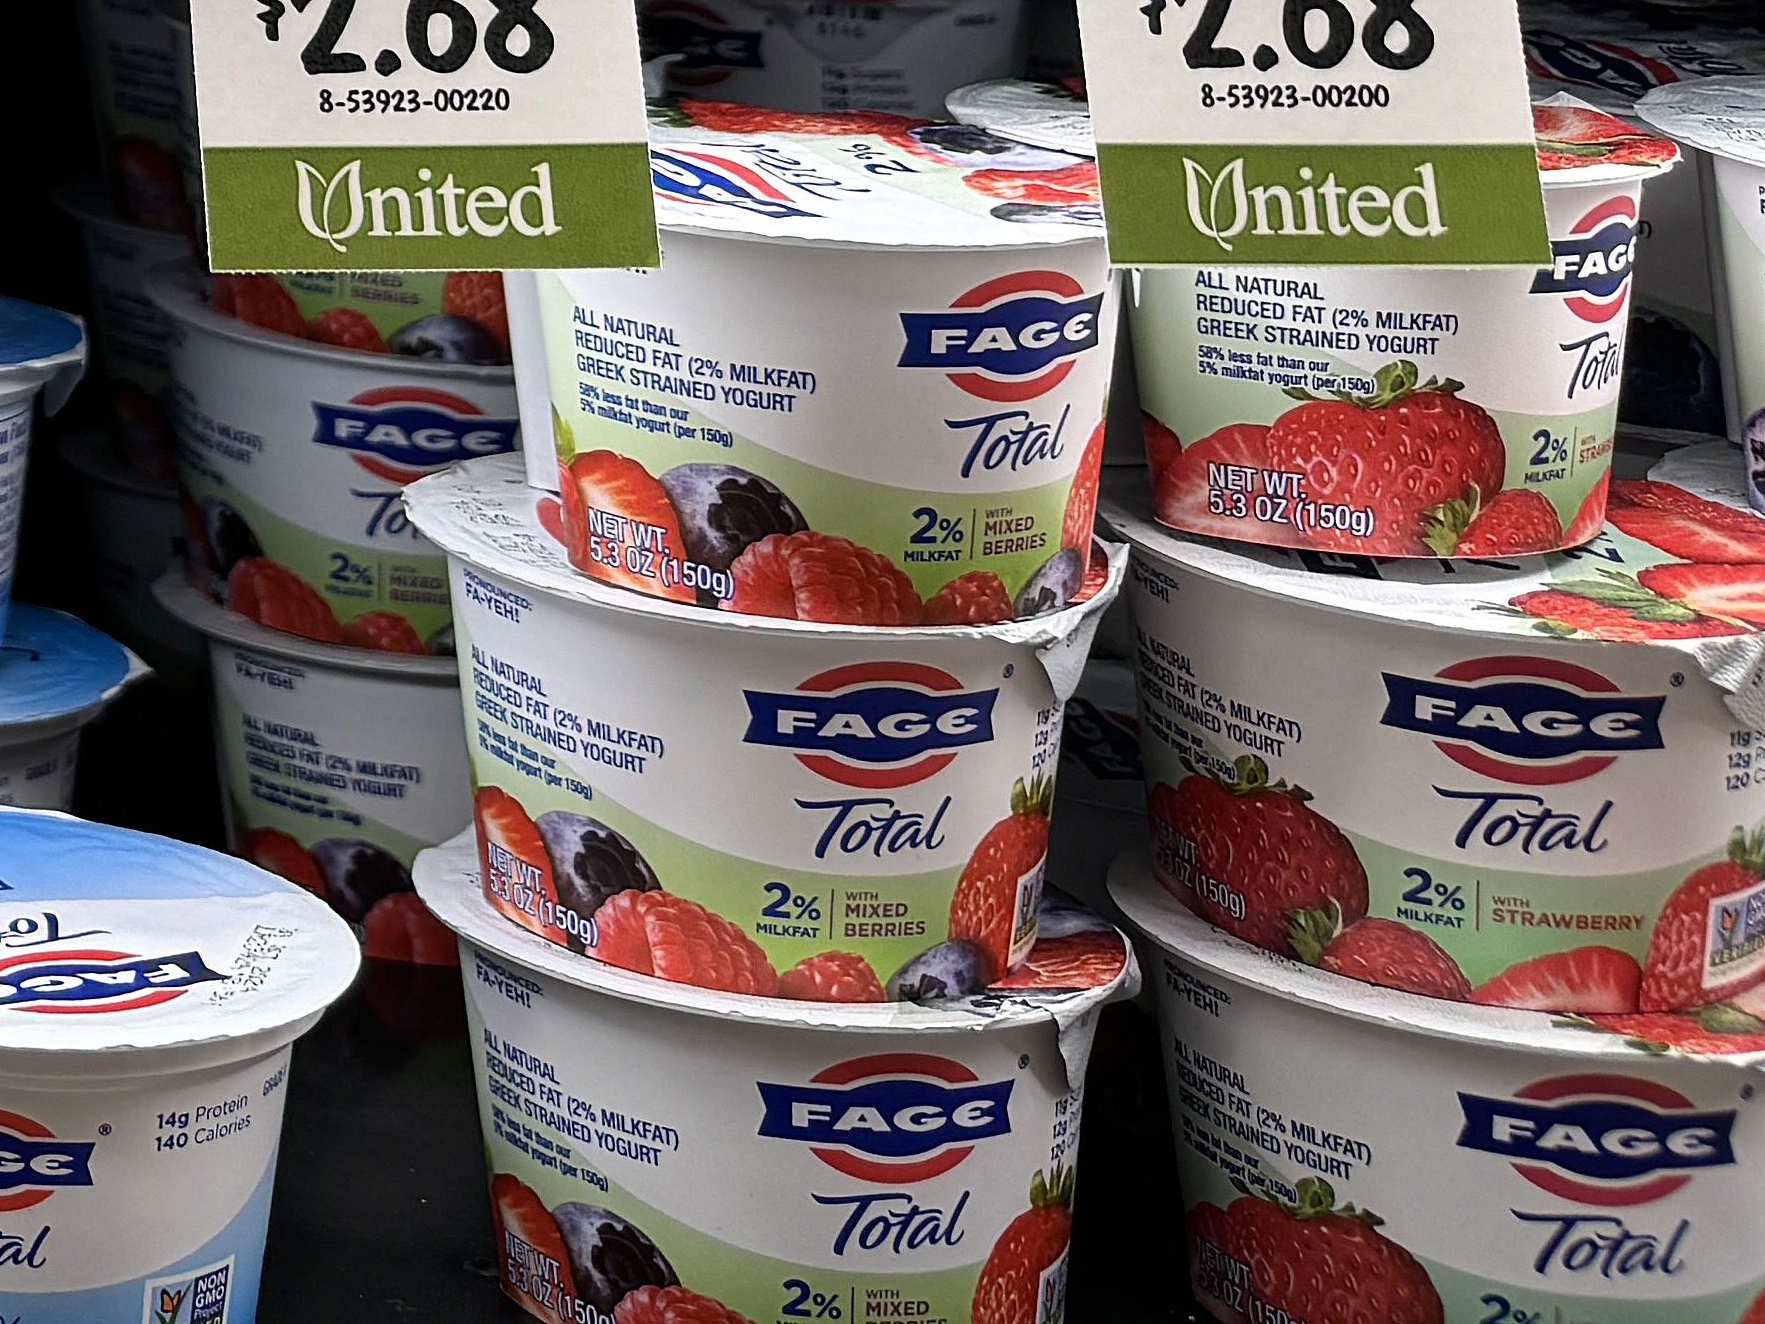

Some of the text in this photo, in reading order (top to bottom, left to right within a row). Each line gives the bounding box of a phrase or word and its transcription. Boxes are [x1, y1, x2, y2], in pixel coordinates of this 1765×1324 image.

[319, 88, 510, 114] 8-53923-00220
[1201, 83, 1390, 110] 8-53923-00200
[295, 158, 562, 254] United
[1184, 156, 1447, 250] United
[573, 306, 680, 345] ALL NATURAL
[575, 331, 818, 395] REDUCED FAT (2% MILKFAT)
[576, 357, 798, 413] GREEK STRAINED YOGURT
[909, 506, 965, 546] 2%
[984, 507, 1013, 520] WITH
[984, 516, 1034, 536] MIXED
[904, 546, 961, 562] MILKFAT
[983, 532, 1047, 556] BERRIES
